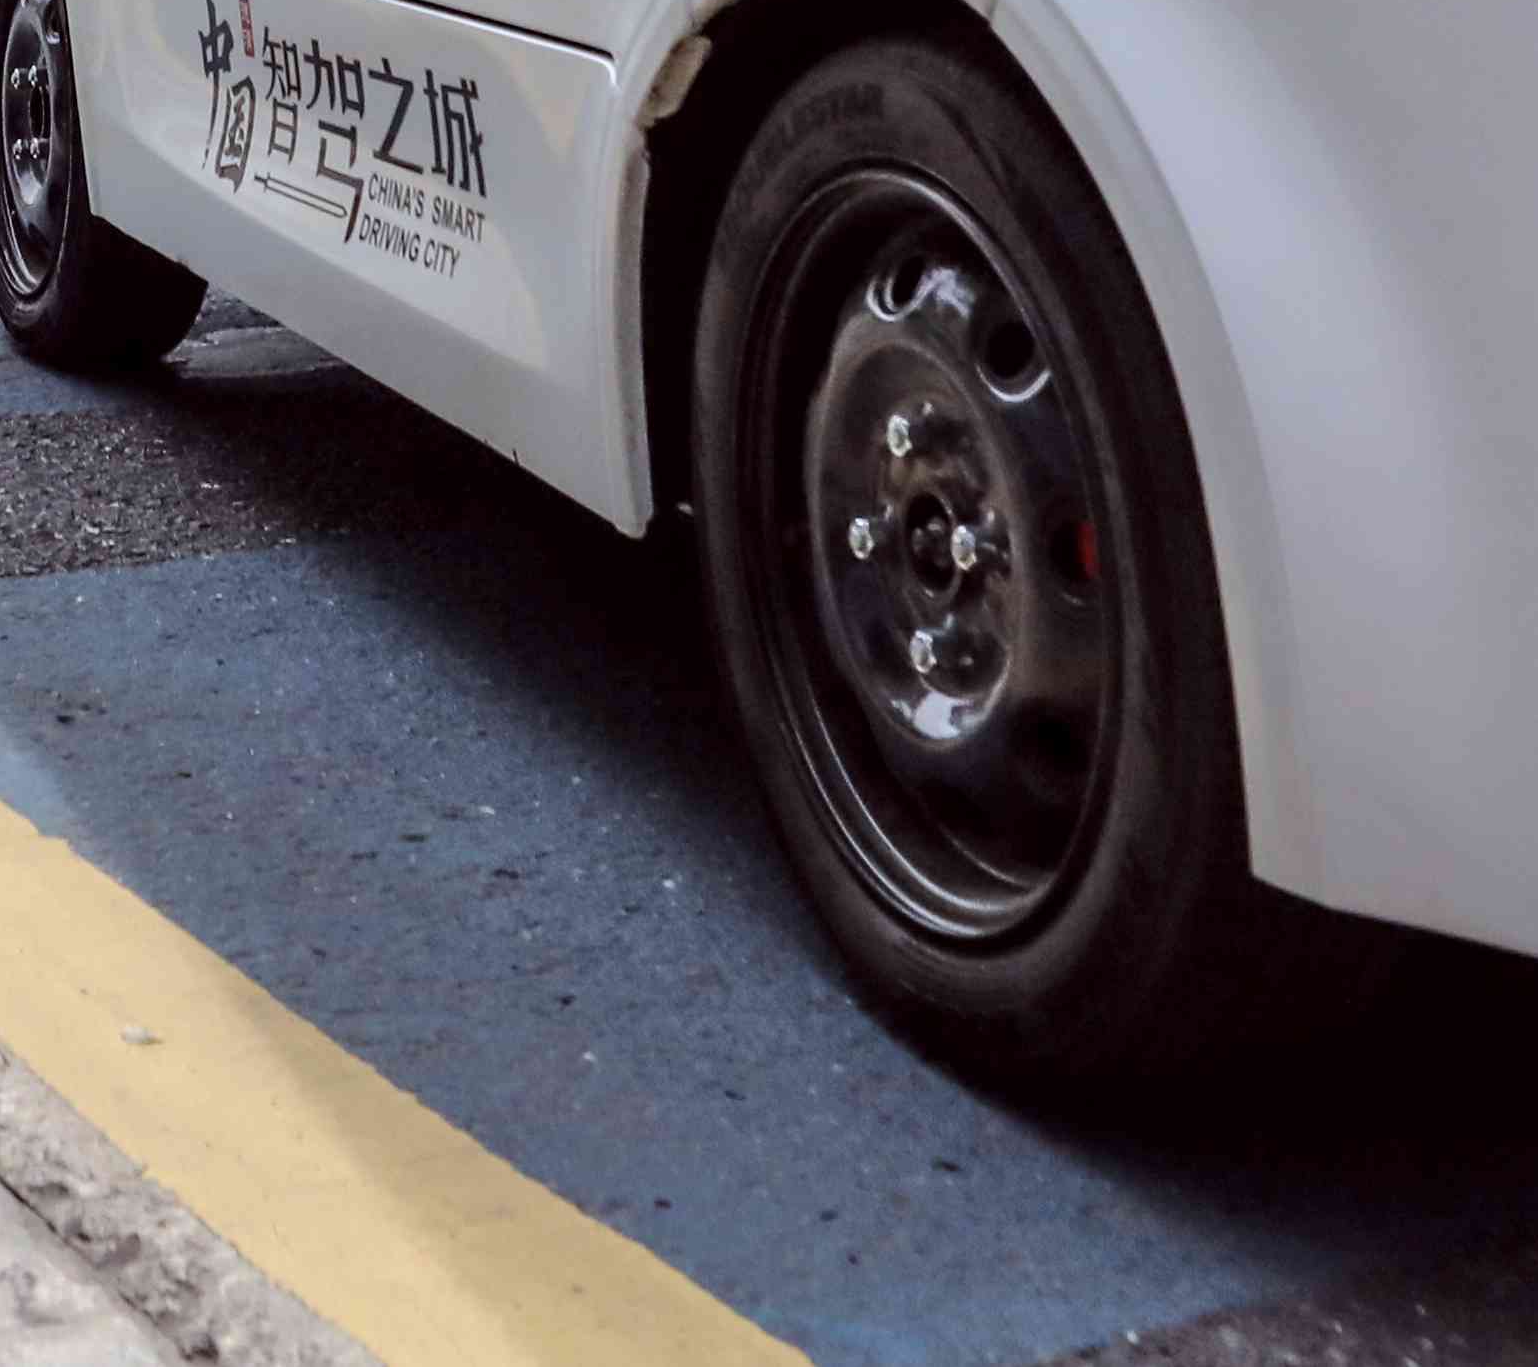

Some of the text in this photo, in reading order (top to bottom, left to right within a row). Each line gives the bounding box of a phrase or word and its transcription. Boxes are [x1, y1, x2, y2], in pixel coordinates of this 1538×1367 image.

[367, 173, 486, 243] CHINA'S SMART
[358, 213, 461, 279] DRIVING CITY
